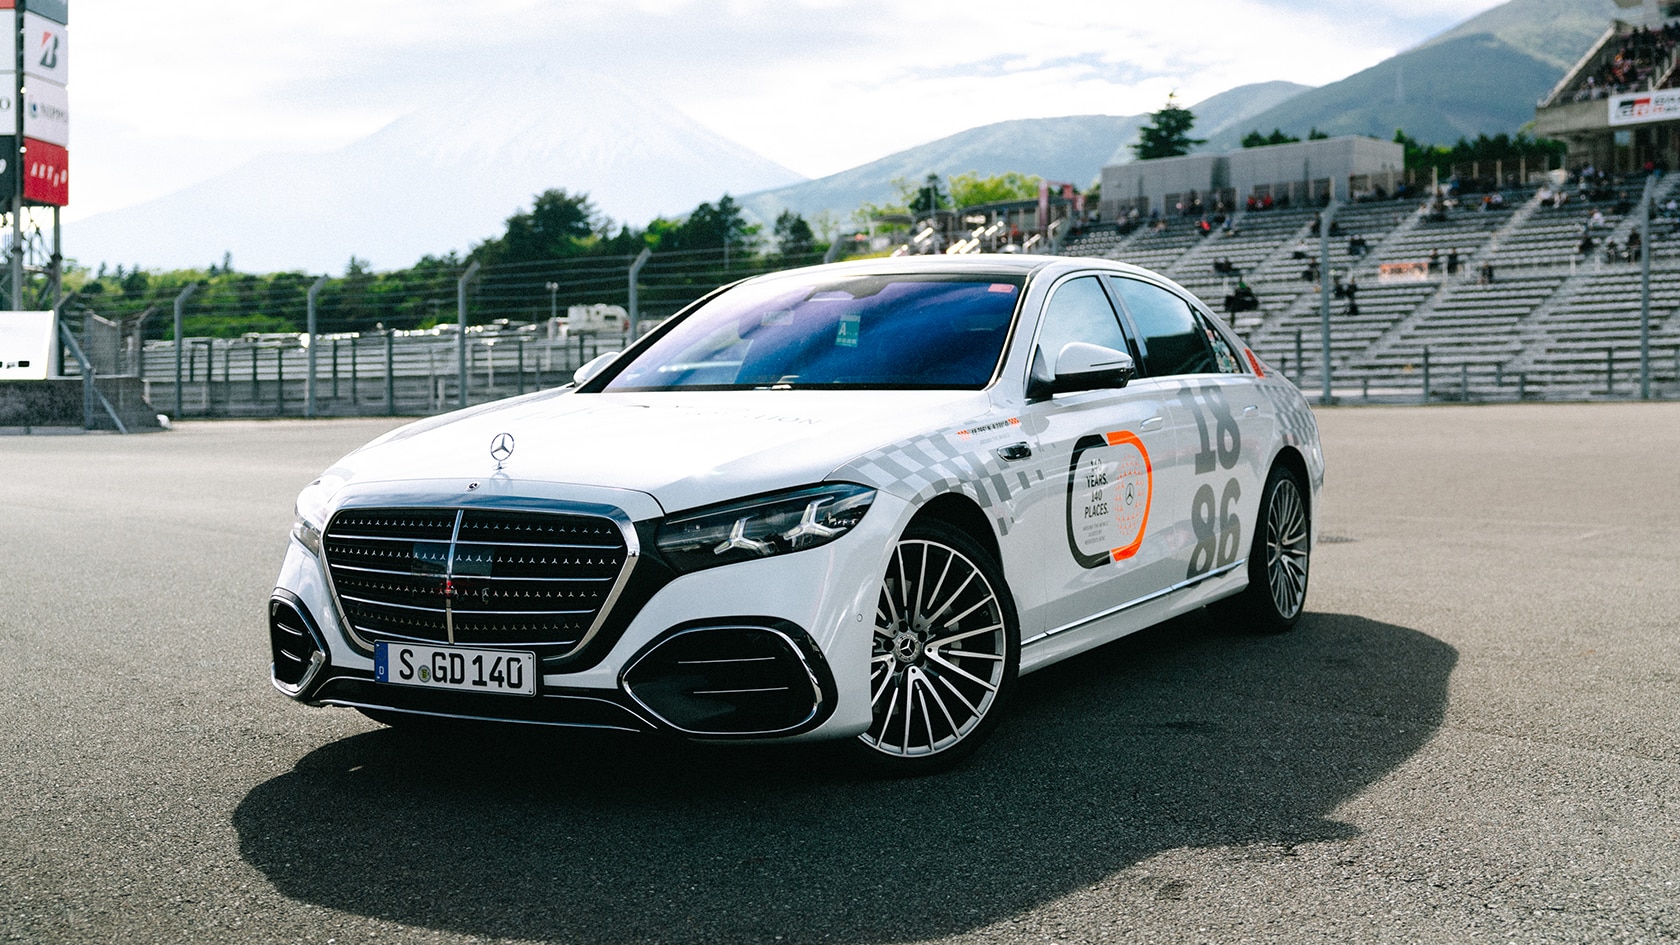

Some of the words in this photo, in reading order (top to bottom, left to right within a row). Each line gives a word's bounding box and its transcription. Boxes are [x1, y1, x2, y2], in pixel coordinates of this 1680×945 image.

[1177, 382, 1241, 475] 18
[1086, 473, 1108, 488] YEARS.
[1091, 489, 1103, 502] 140
[1084, 502, 1109, 519] PLACES.
[1186, 477, 1241, 587] 86
[399, 649, 414, 680] S
[432, 651, 465, 684] GD
[472, 655, 523, 689] 140
